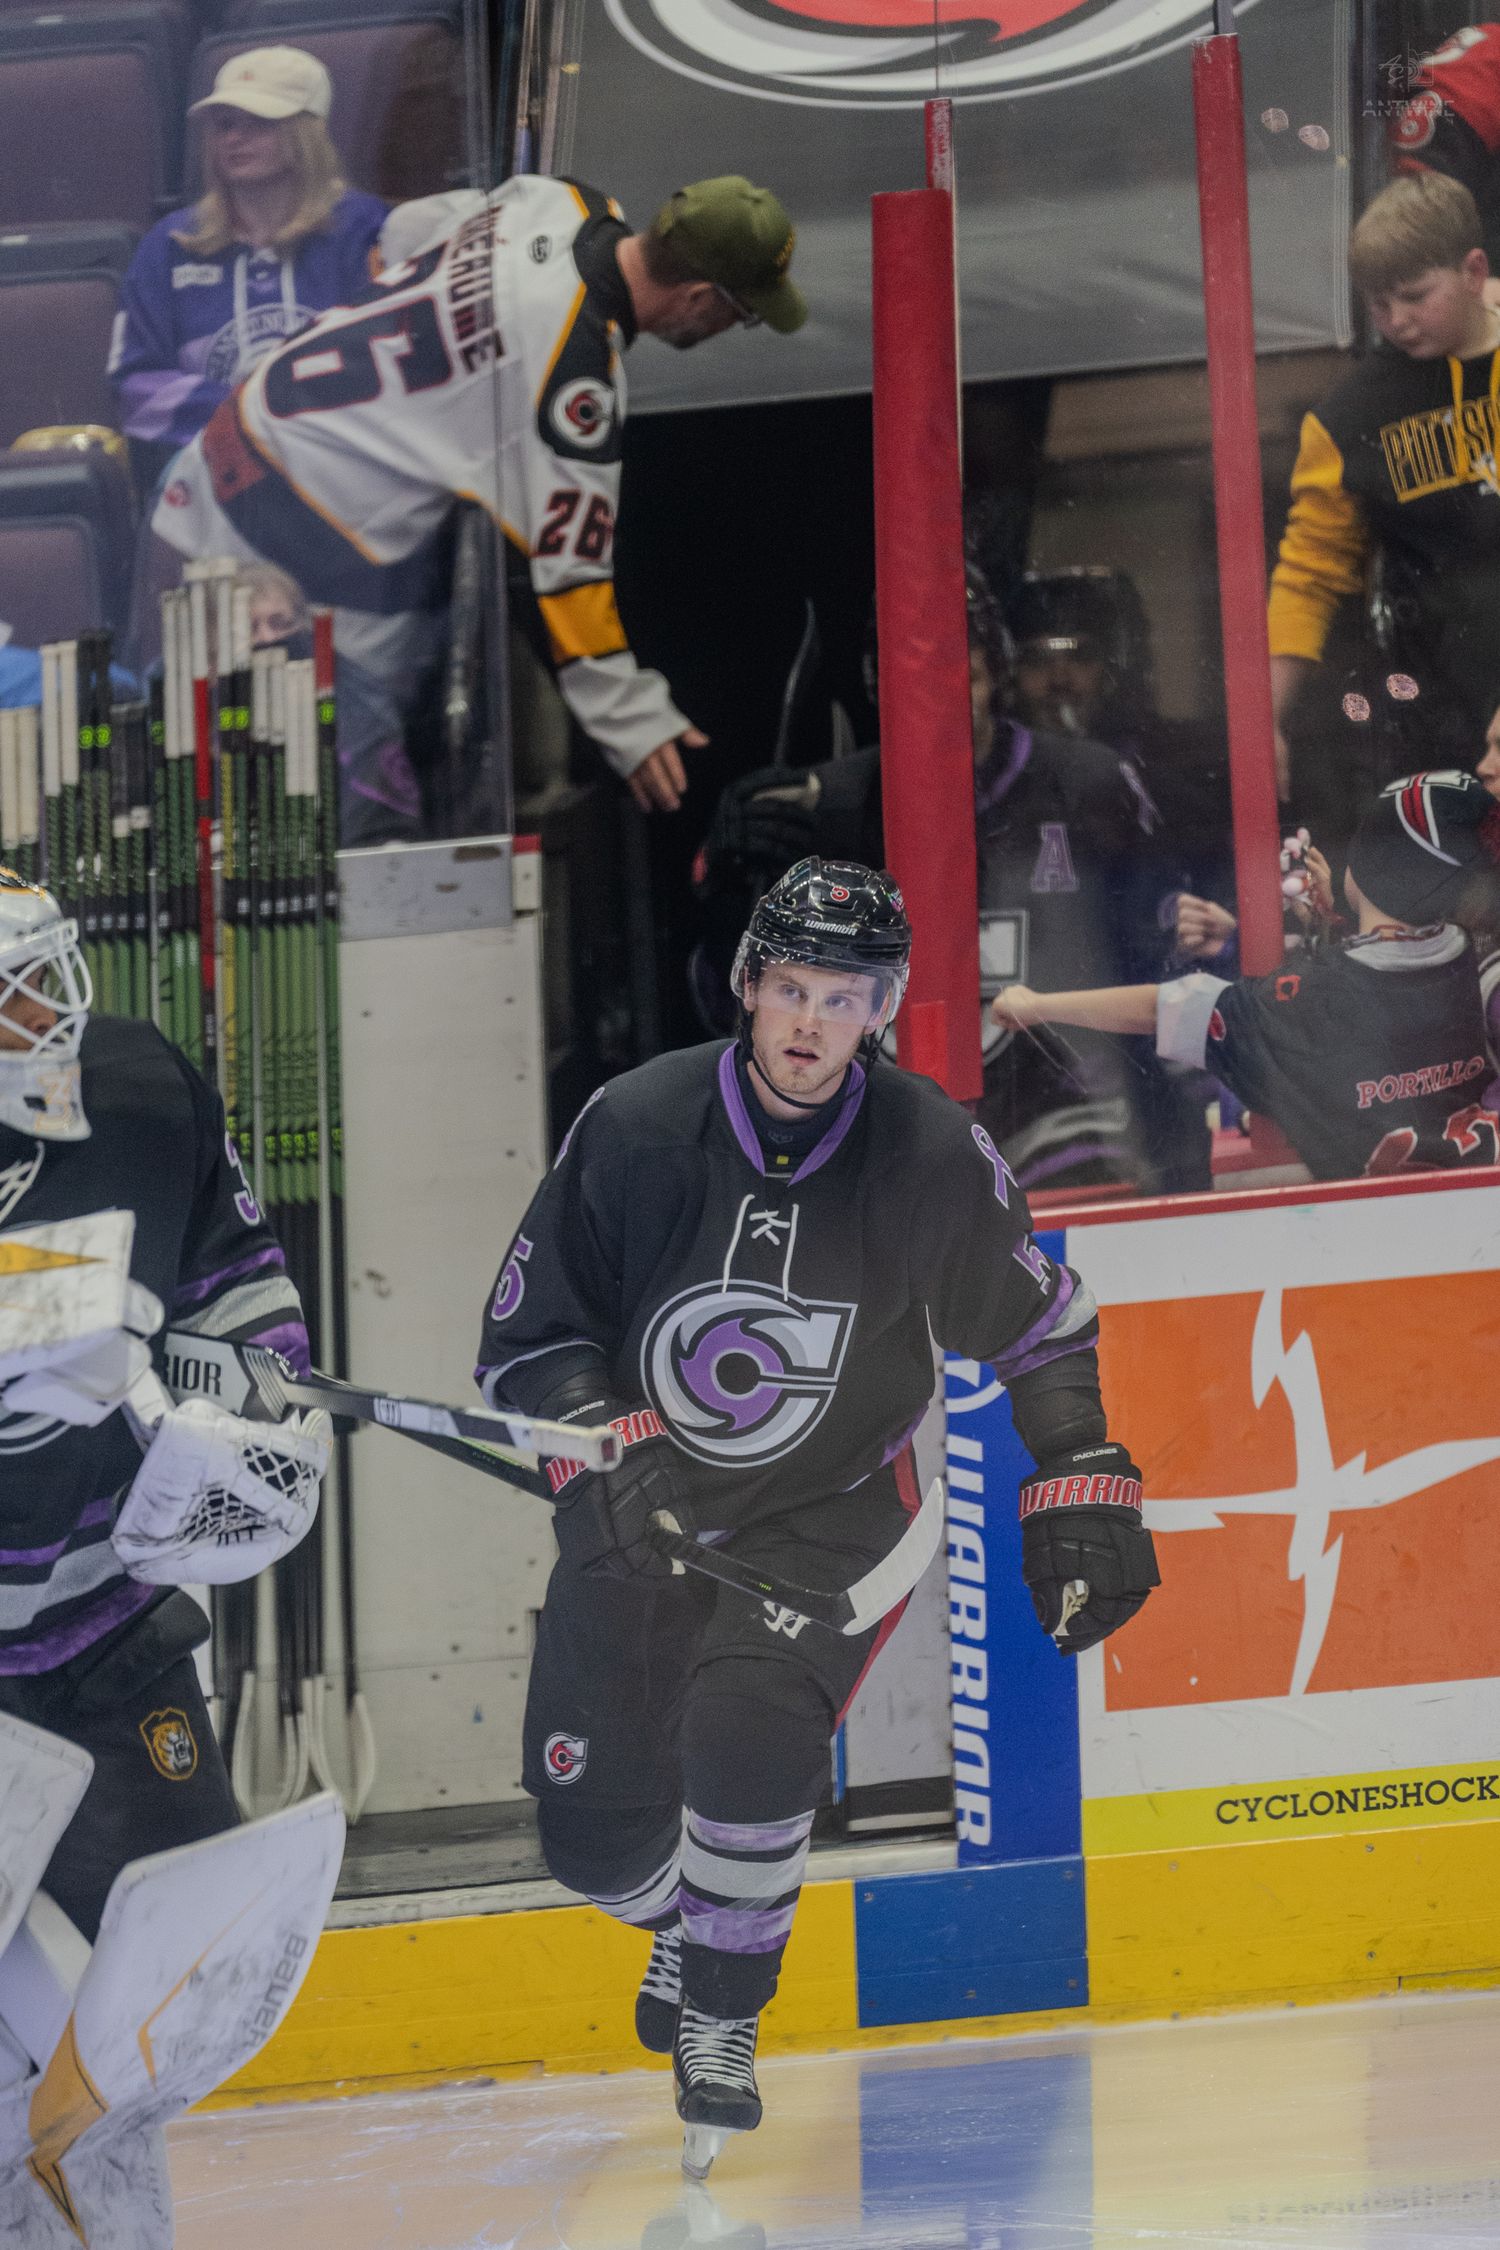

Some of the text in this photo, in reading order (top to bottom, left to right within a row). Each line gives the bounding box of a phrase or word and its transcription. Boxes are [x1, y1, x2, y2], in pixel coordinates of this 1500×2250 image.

[537, 489, 614, 560] 26
[1031, 823, 1079, 893] A
[805, 918, 858, 936] WARRIOR
[1356, 1055, 1485, 1109] PORTILLO
[165, 1353, 222, 1396] IOR
[1072, 1447, 1118, 1462] CYCLONES
[1216, 1774, 1500, 1825] CYCLONESHOCK
